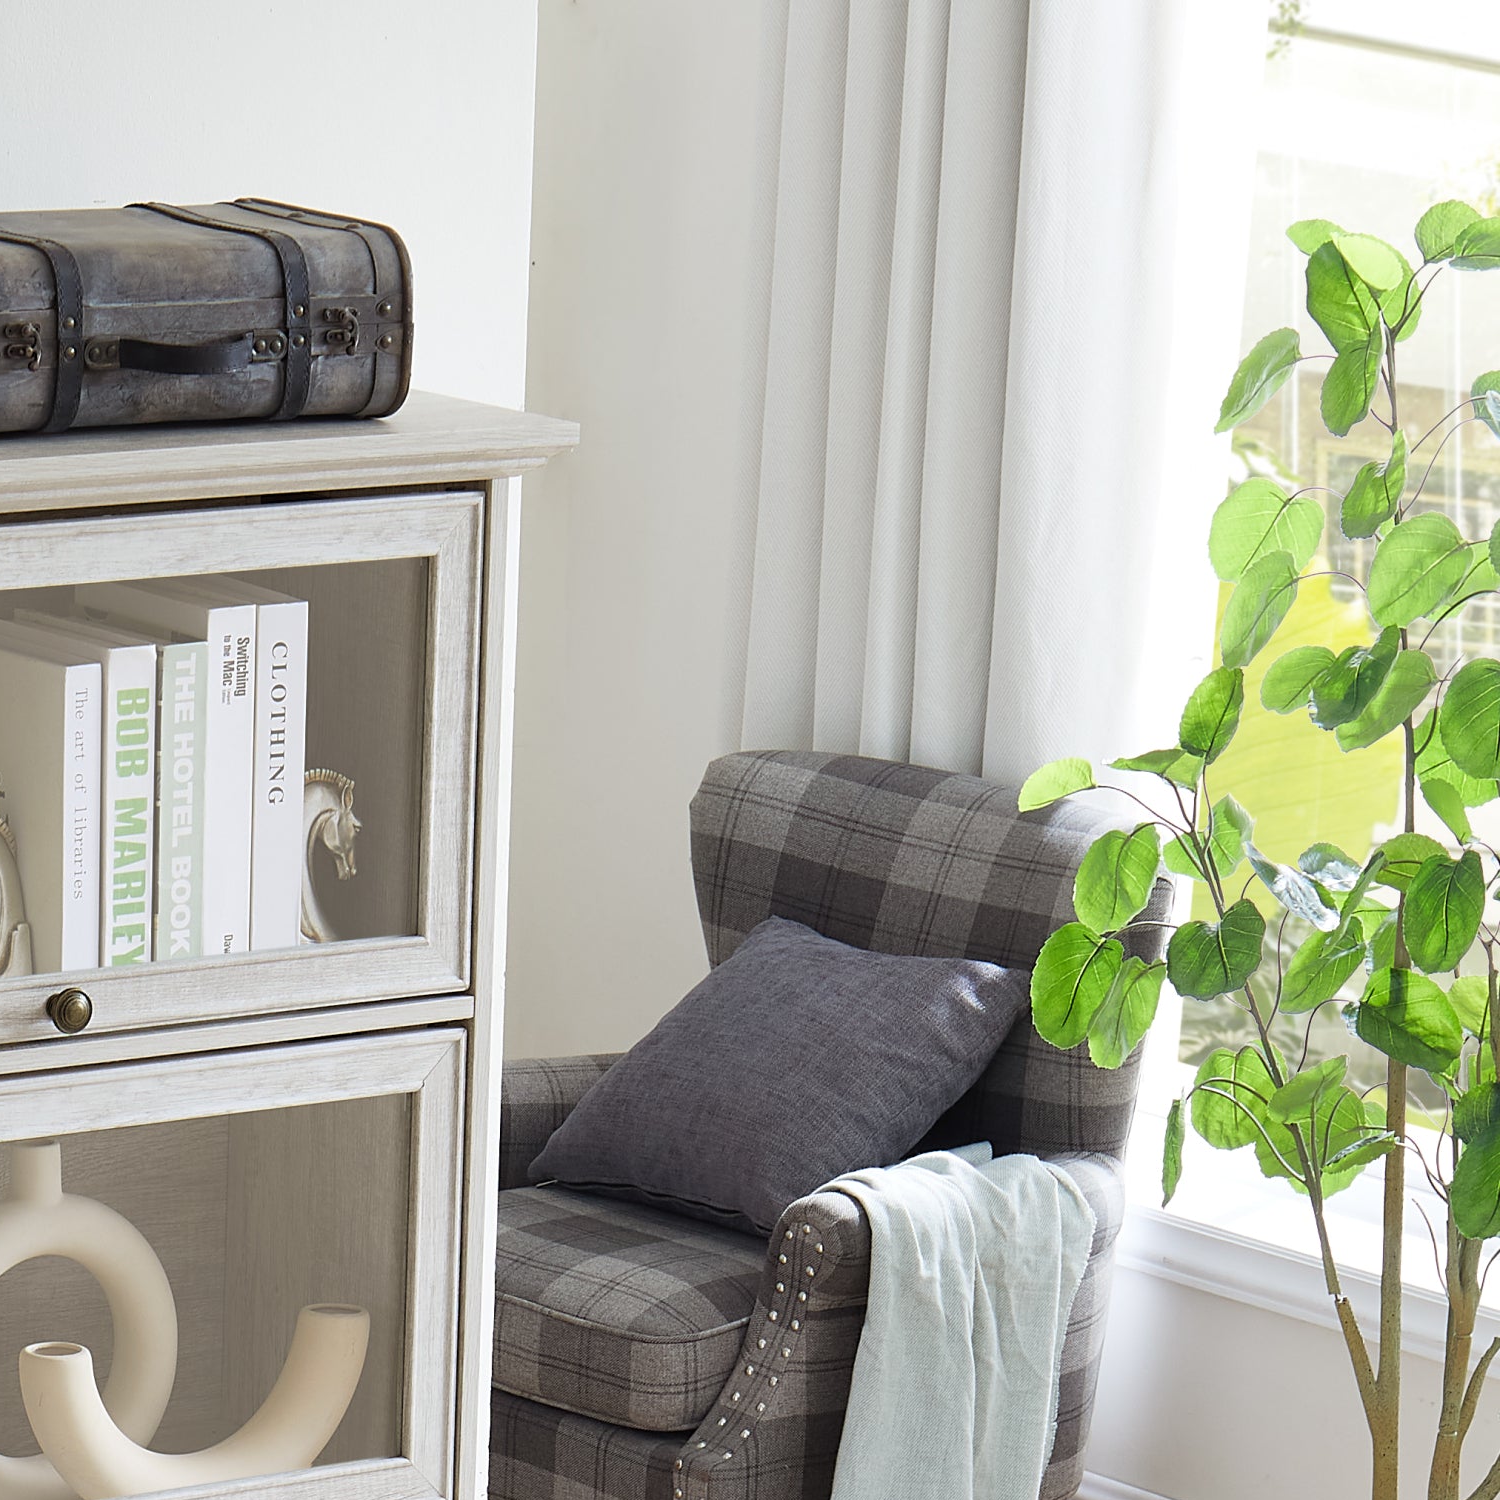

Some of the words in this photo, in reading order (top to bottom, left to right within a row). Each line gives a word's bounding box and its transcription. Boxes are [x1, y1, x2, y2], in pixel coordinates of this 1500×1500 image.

[223, 635, 231, 643] to
[223, 645, 231, 657] the
[234, 636, 250, 697] Switching
[74, 687, 89, 720] The
[173, 652, 197, 724] THE
[222, 660, 235, 687] Mac
[74, 731, 85, 760] art
[115, 687, 150, 778] BOB
[268, 641, 289, 806] CLOTHING
[74, 773, 87, 793] of
[171, 732, 194, 848] HOTEL
[73, 807, 87, 900] libraries
[111, 796, 148, 966] MARLEY
[170, 855, 192, 956] BOOK
